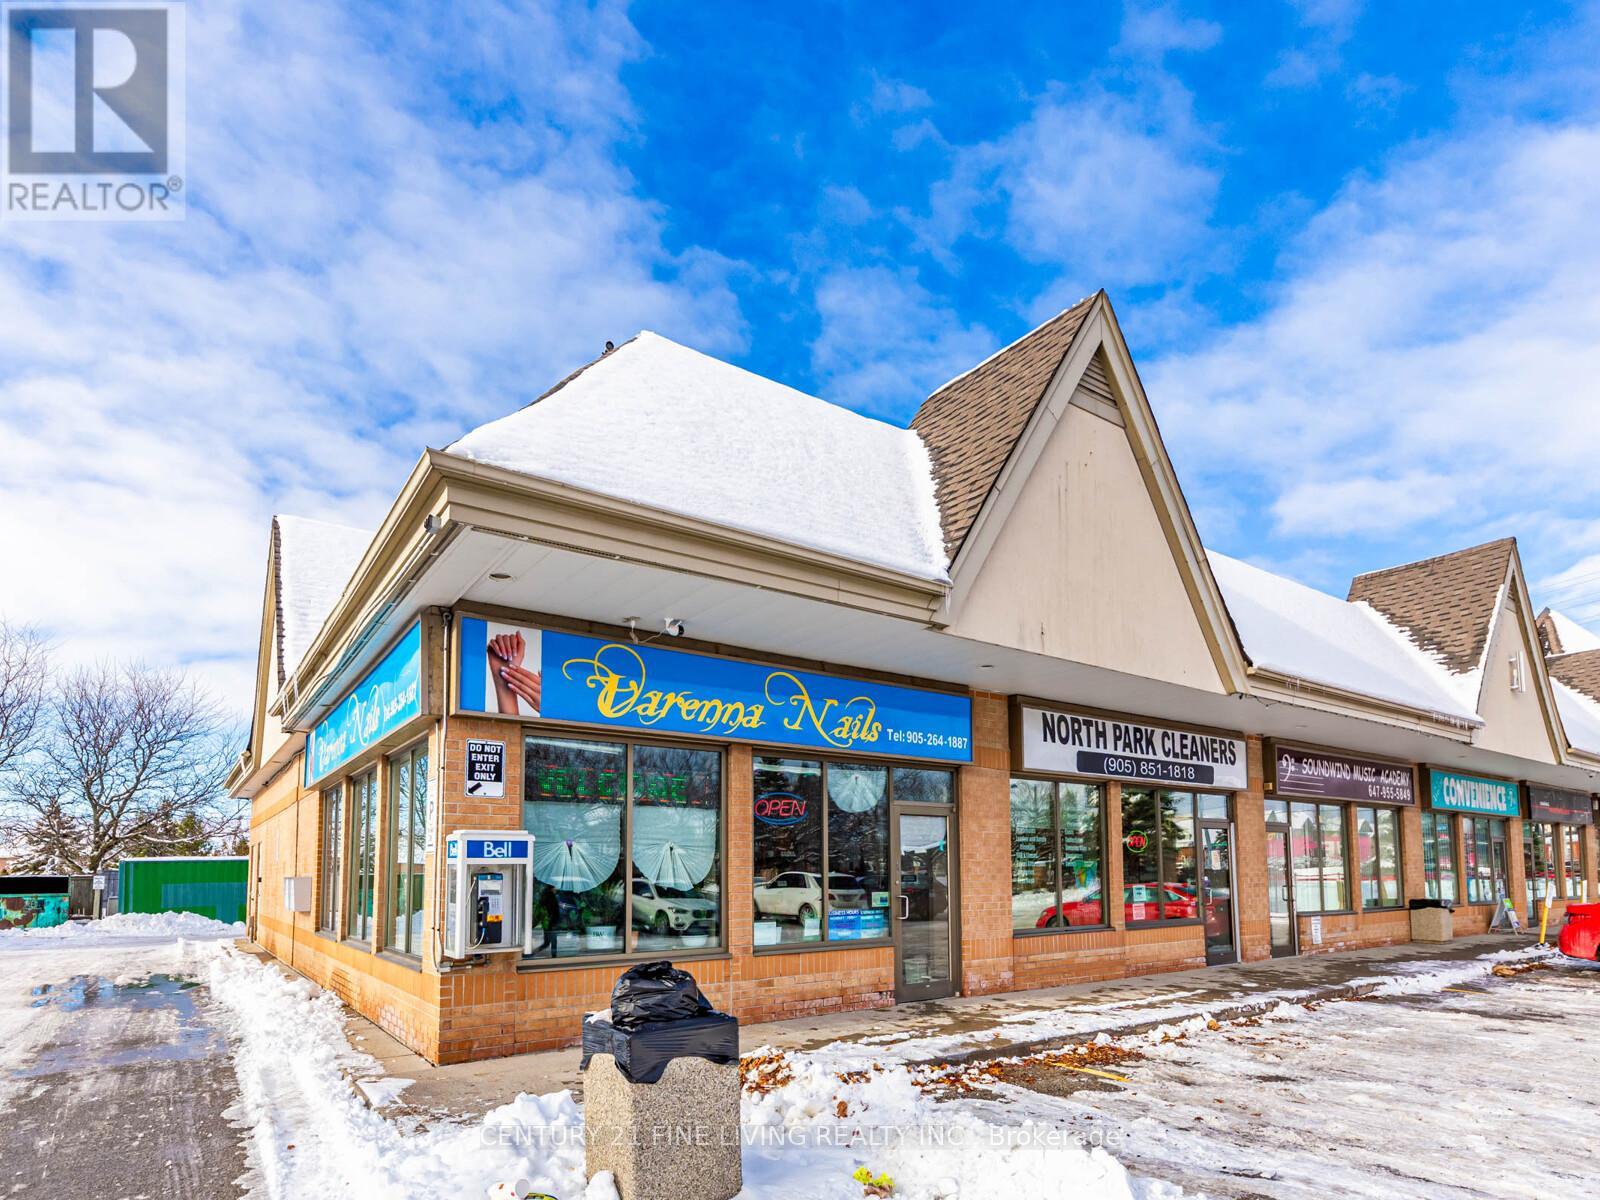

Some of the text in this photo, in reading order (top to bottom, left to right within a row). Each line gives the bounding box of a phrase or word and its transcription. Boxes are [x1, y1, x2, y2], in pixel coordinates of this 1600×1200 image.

[562, 644, 882, 748] Varenna Nails
[887, 728, 968, 749] Tel: 905-264-1887
[1041, 712, 1236, 766] NORTH PARK CLEANERS
[470, 744, 501, 753] DO NOT
[471, 754, 499, 762] ENTER
[474, 772, 496, 781] ONLY
[475, 763, 495, 772] EXIT
[1103, 757, 1195, 780] (905) 851-1818
[1302, 758, 1411, 787] SOUNDWIND MUSIC ACADEMY
[1443, 777, 1507, 811] CONVENIENCE
[754, 800, 806, 816] OPEN
[483, 842, 511, 857] Bell
